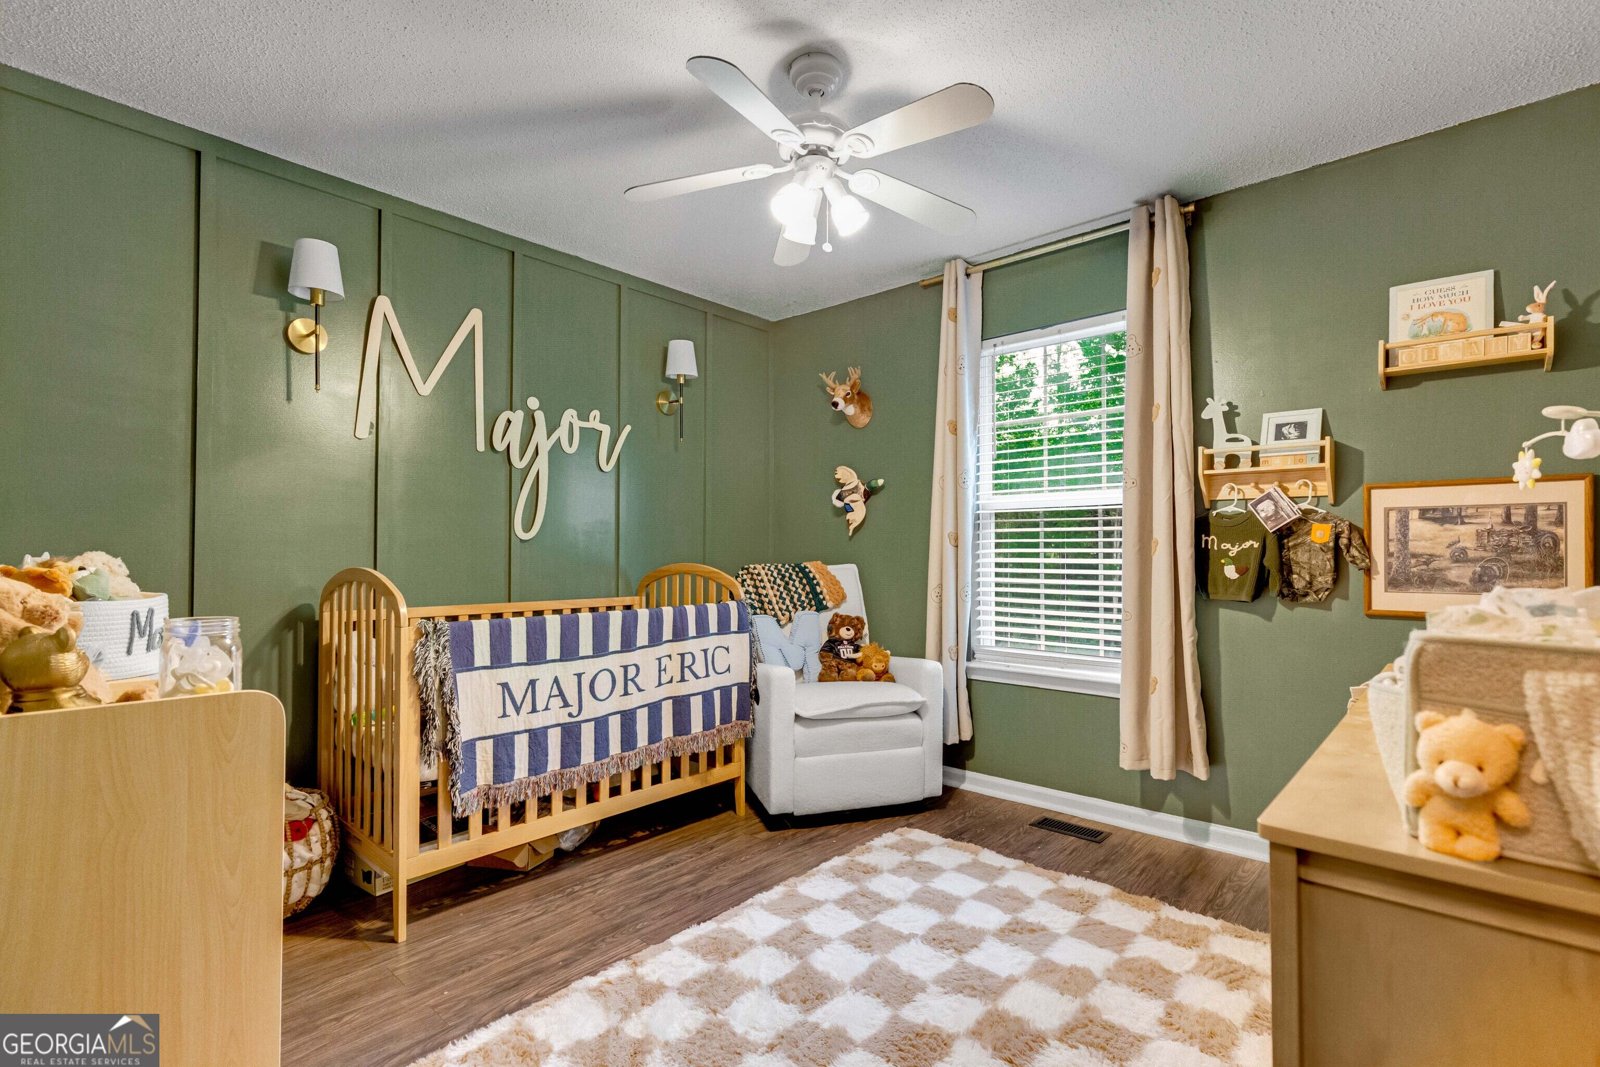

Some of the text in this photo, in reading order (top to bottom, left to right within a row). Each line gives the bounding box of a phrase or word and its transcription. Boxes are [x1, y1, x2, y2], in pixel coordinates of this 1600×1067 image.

[1412, 289, 1469, 304] HOW MUCH
[1417, 299, 1446, 310] LOVE
[1448, 295, 1471, 305] YOU
[355, 295, 631, 540] Major
[497, 645, 731, 719] MAJOR ERIC
